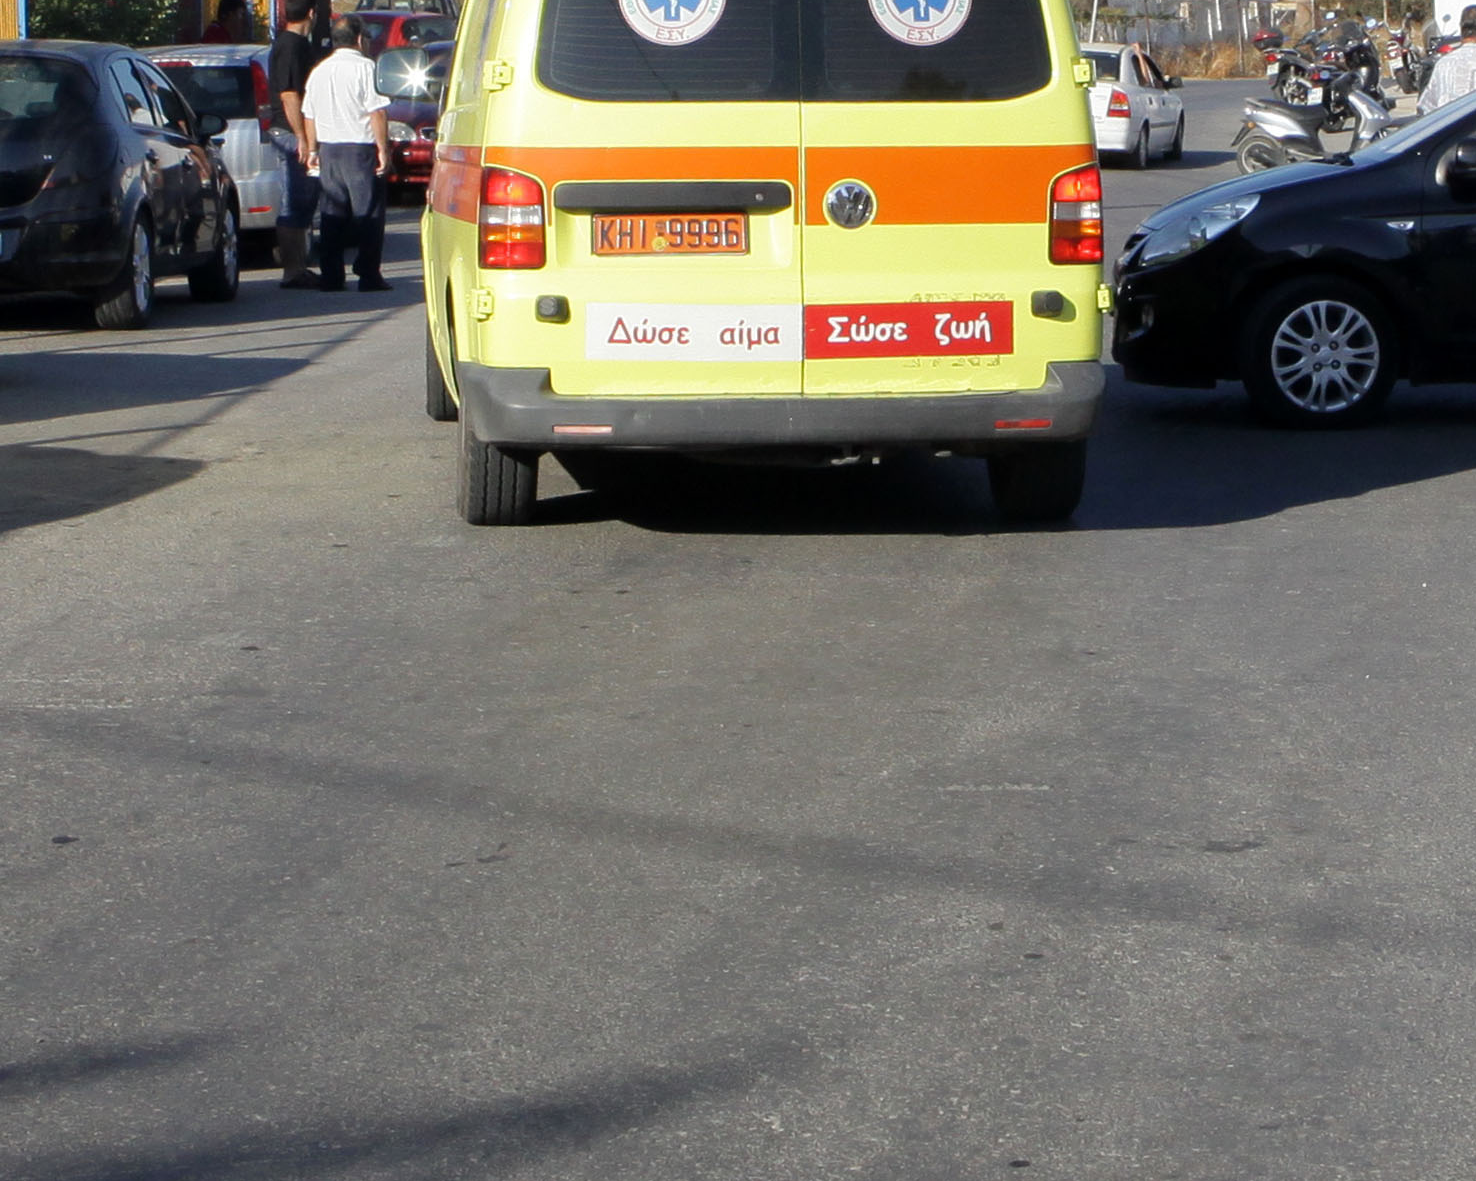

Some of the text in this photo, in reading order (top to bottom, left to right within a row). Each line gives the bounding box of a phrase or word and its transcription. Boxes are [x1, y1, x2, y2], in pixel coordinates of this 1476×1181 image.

[906, 28, 940, 41] Ε.Σ.Υ.
[606, 316, 781, 350] Δώσε αίμα
[827, 312, 992, 345] Σώσε ζωή
